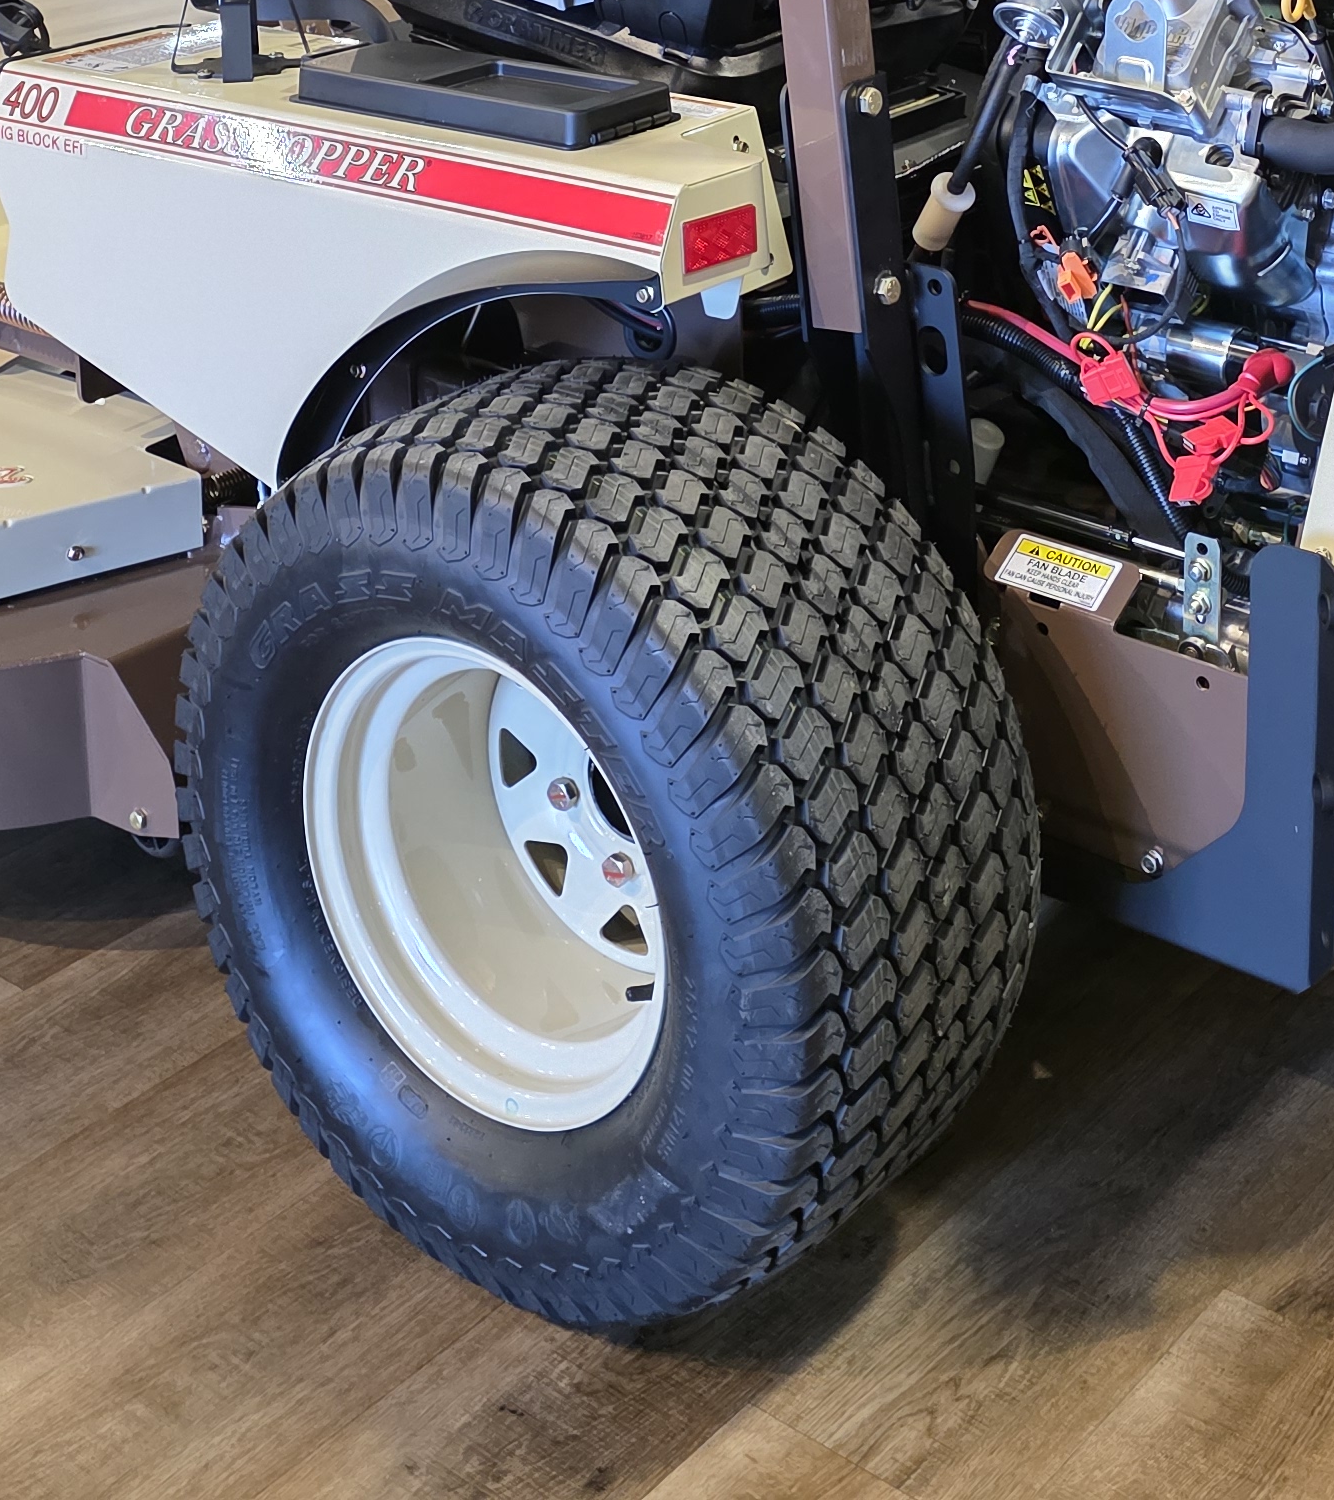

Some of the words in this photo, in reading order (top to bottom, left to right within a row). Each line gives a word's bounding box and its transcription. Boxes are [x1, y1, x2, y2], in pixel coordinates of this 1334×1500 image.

[488, 9, 602, 65] GRAMMER
[2, 80, 60, 124] 400
[16, 128, 61, 151] BLOCK
[63, 136, 84, 156] EFI
[1026, 559, 1050, 571] FAN
[1050, 565, 1088, 583] BLADE
[1045, 550, 1101, 574] CAUTION
[1026, 568, 1042, 578] KEEP
[1041, 573, 1060, 583] HANDS
[1060, 578, 1079, 588] CLEAR
[1027, 576, 1046, 587] CAUSE
[1046, 581, 1073, 596] PERSONAL
[249, 568, 417, 669] GRASS
[431, 587, 666, 847] MASTER
